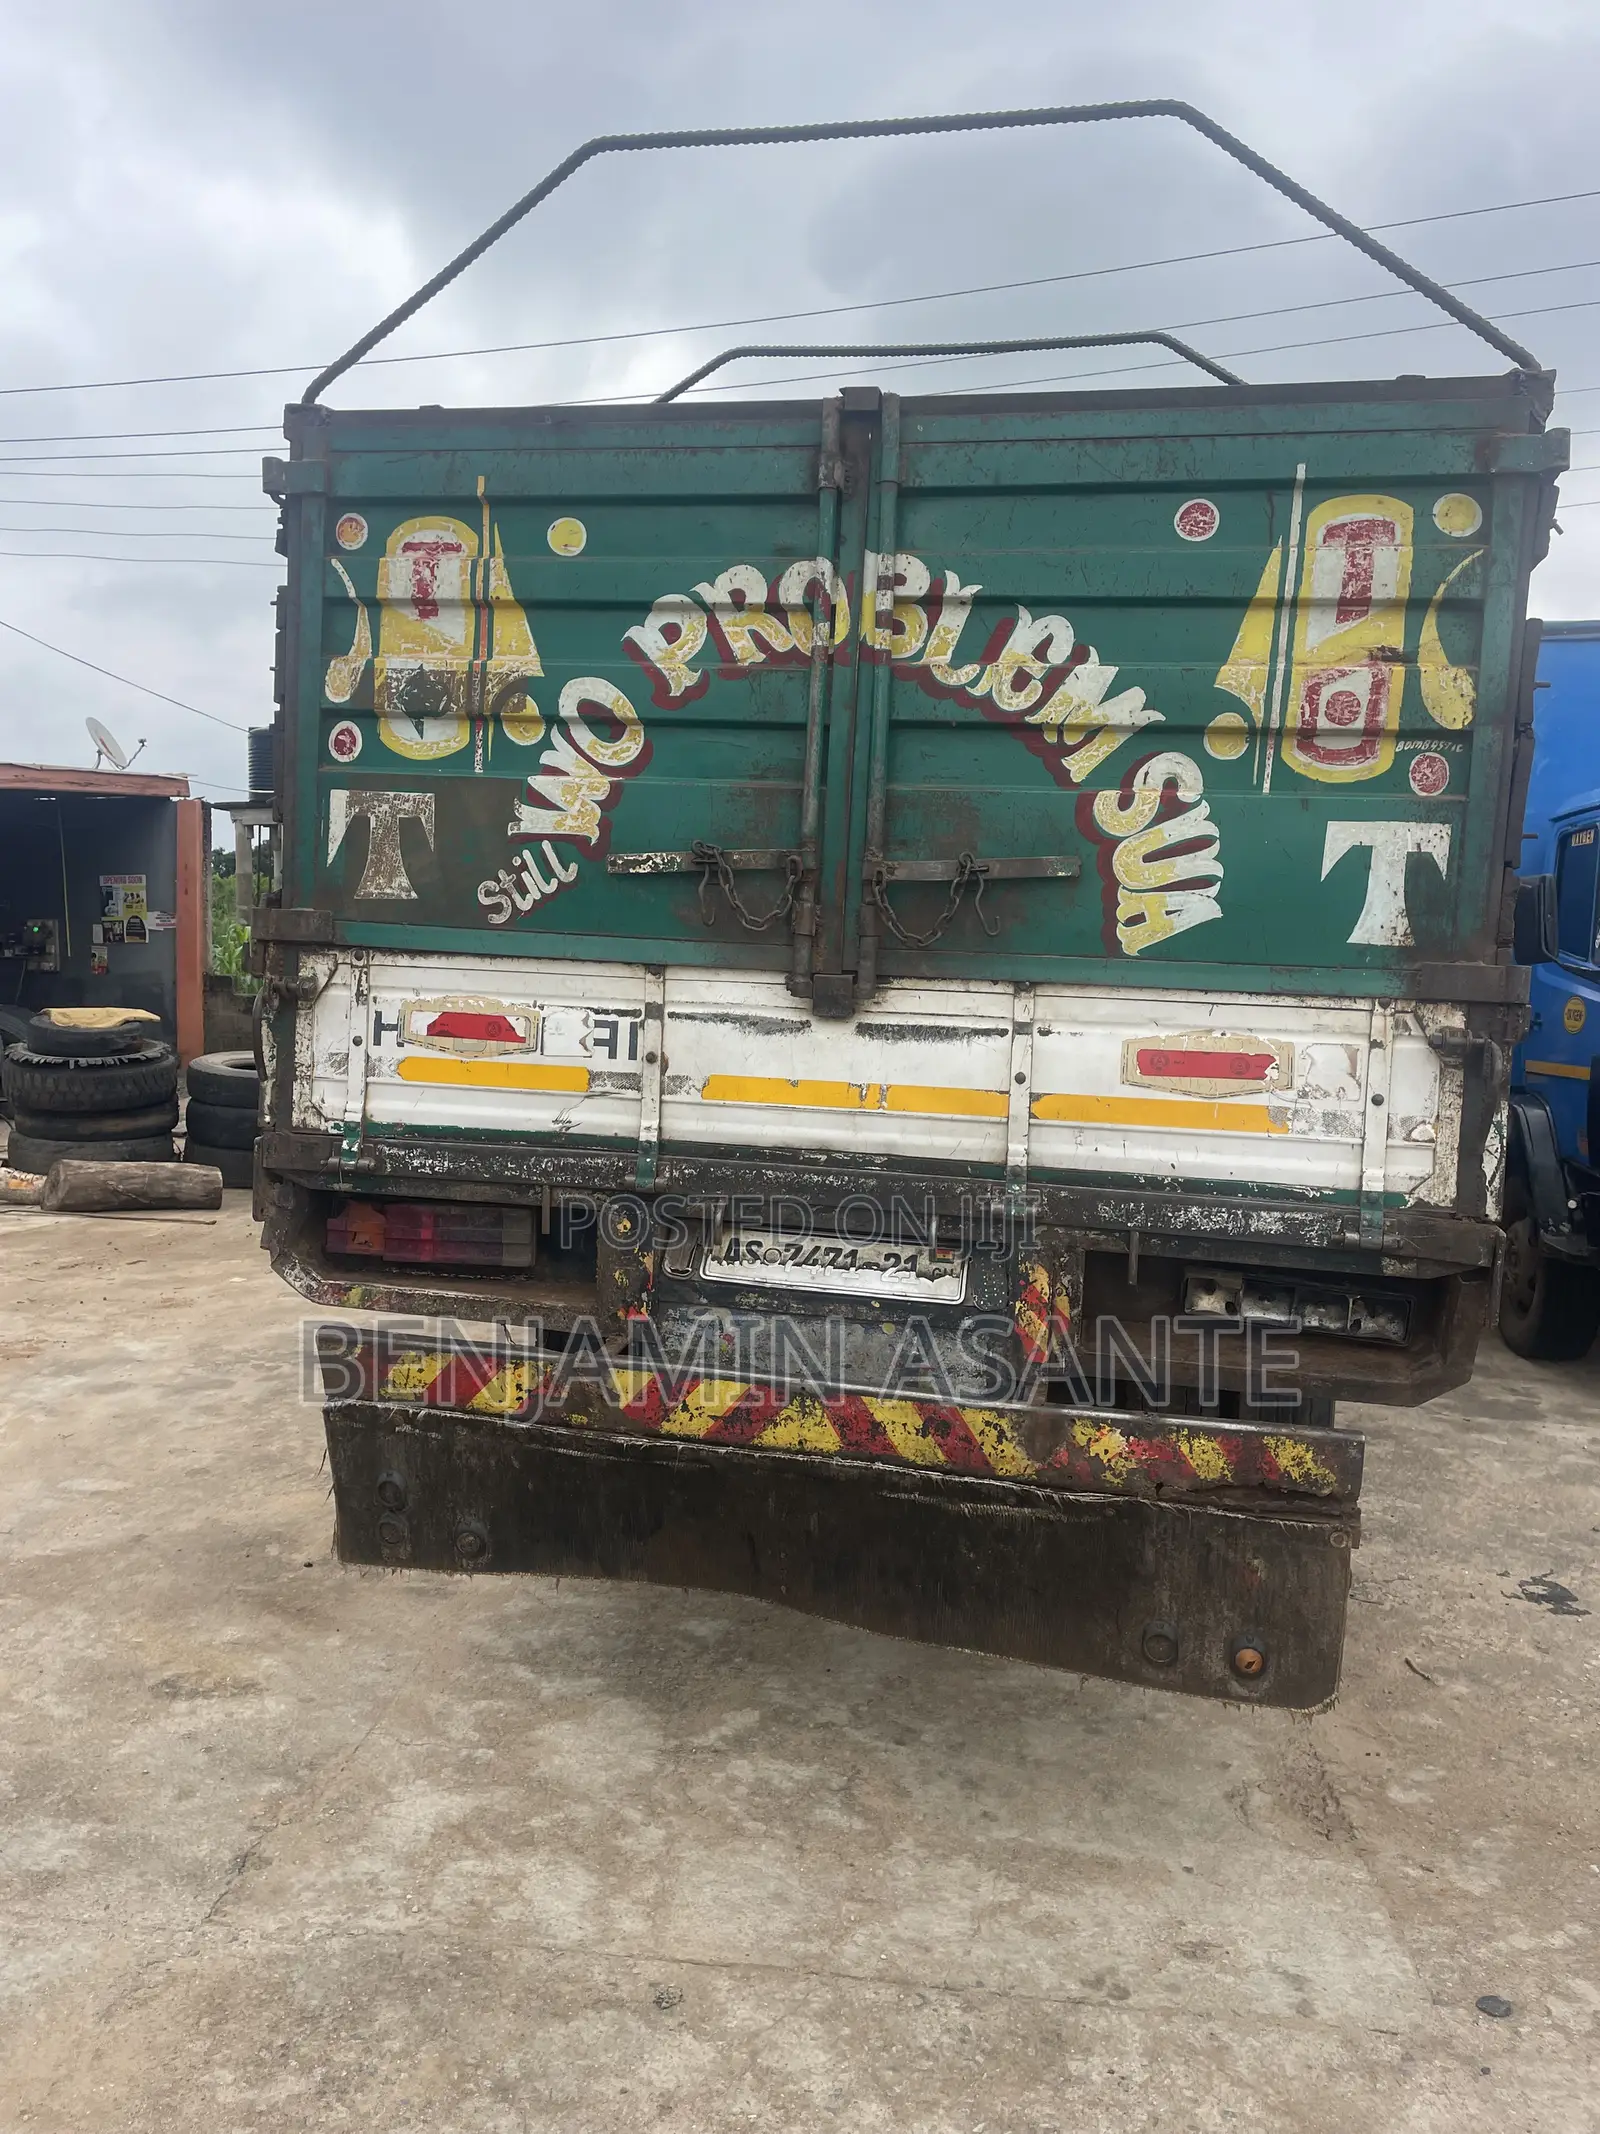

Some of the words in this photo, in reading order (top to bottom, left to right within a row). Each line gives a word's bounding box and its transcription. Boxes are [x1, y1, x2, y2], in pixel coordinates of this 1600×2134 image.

[621, 549, 1167, 784] PROBLEM
[507, 676, 646, 846] NO
[326, 789, 436, 900] T
[477, 839, 579, 924] Still
[1092, 751, 1224, 957] SUA
[1320, 820, 1453, 947] T
[723, 1237, 764, 1269] AS
